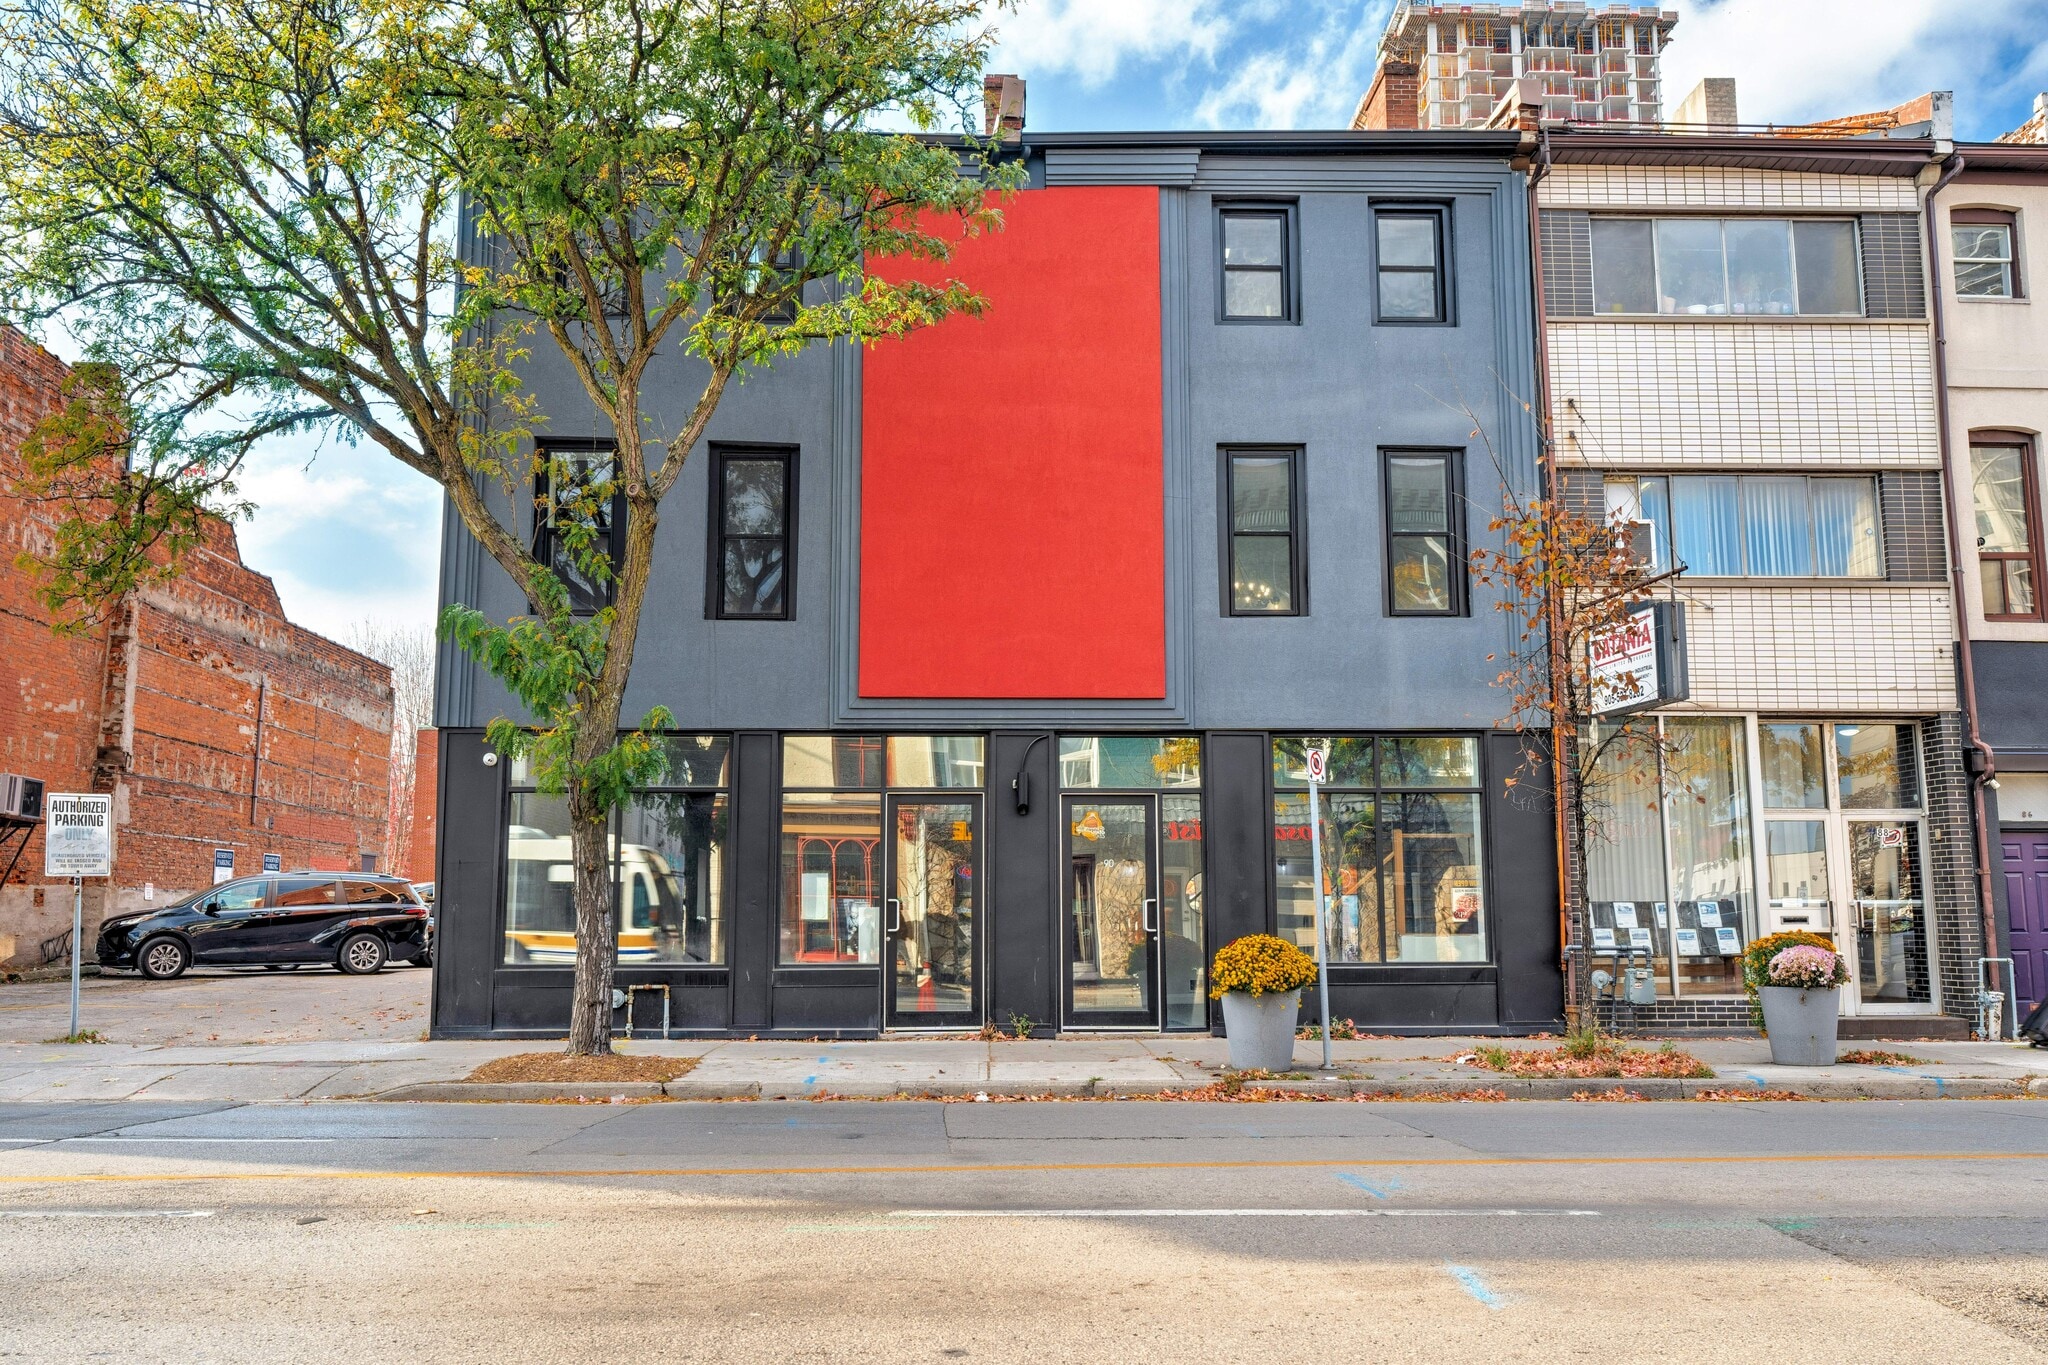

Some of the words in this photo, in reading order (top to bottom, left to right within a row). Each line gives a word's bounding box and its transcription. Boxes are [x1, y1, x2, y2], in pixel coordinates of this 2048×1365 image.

[52, 800, 107, 814] AUTHORIZED
[55, 814, 104, 827] PARKING
[65, 828, 94, 841] ONLY
[1877, 828, 1889, 837] 88
[1103, 859, 1115, 868] 90
